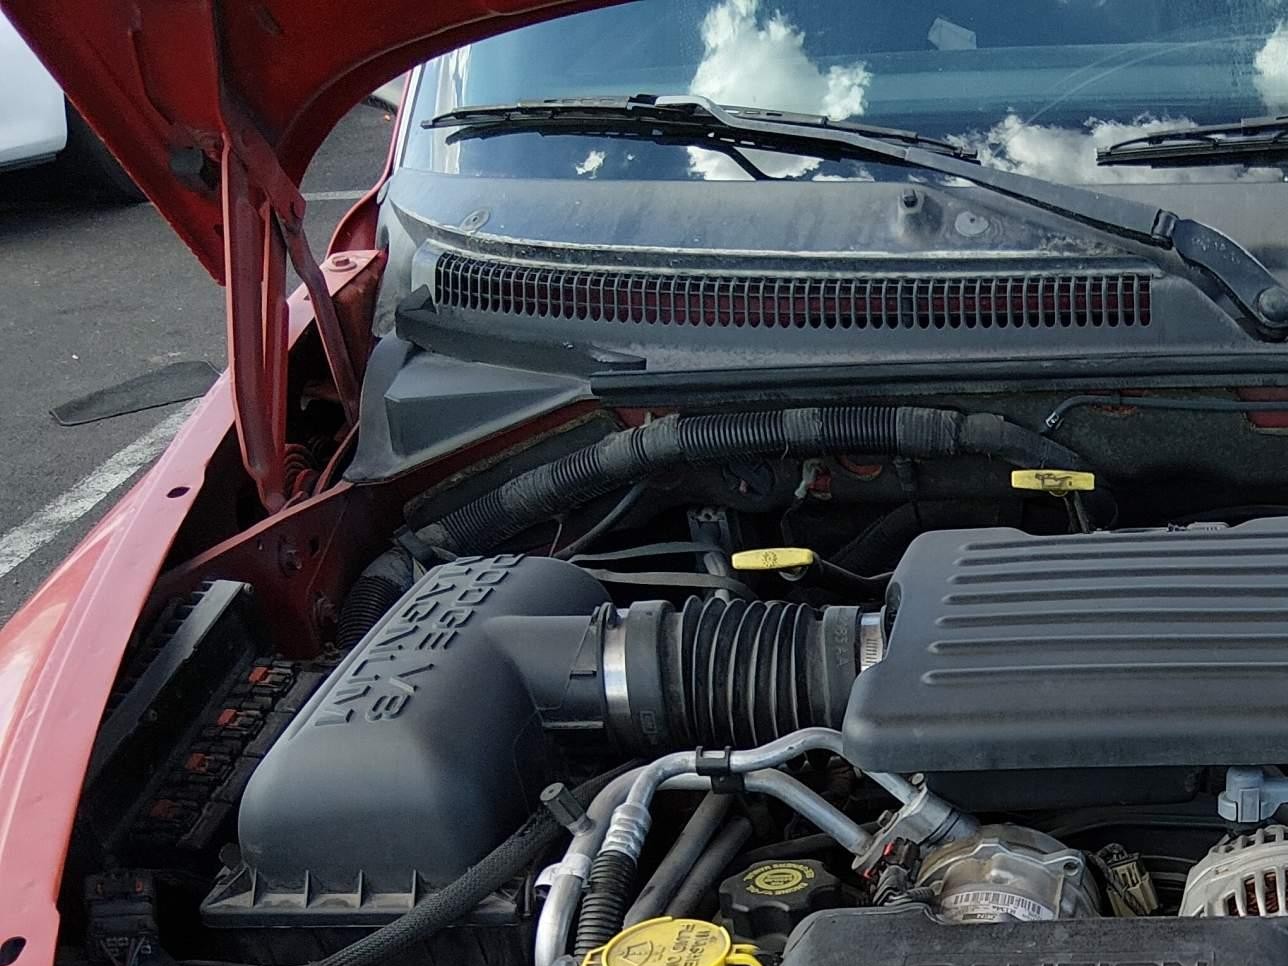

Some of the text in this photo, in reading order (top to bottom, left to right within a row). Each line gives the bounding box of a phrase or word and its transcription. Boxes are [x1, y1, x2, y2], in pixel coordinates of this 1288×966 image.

[313, 554, 487, 729] MAGNUM
[364, 552, 527, 723] DODGE V8
